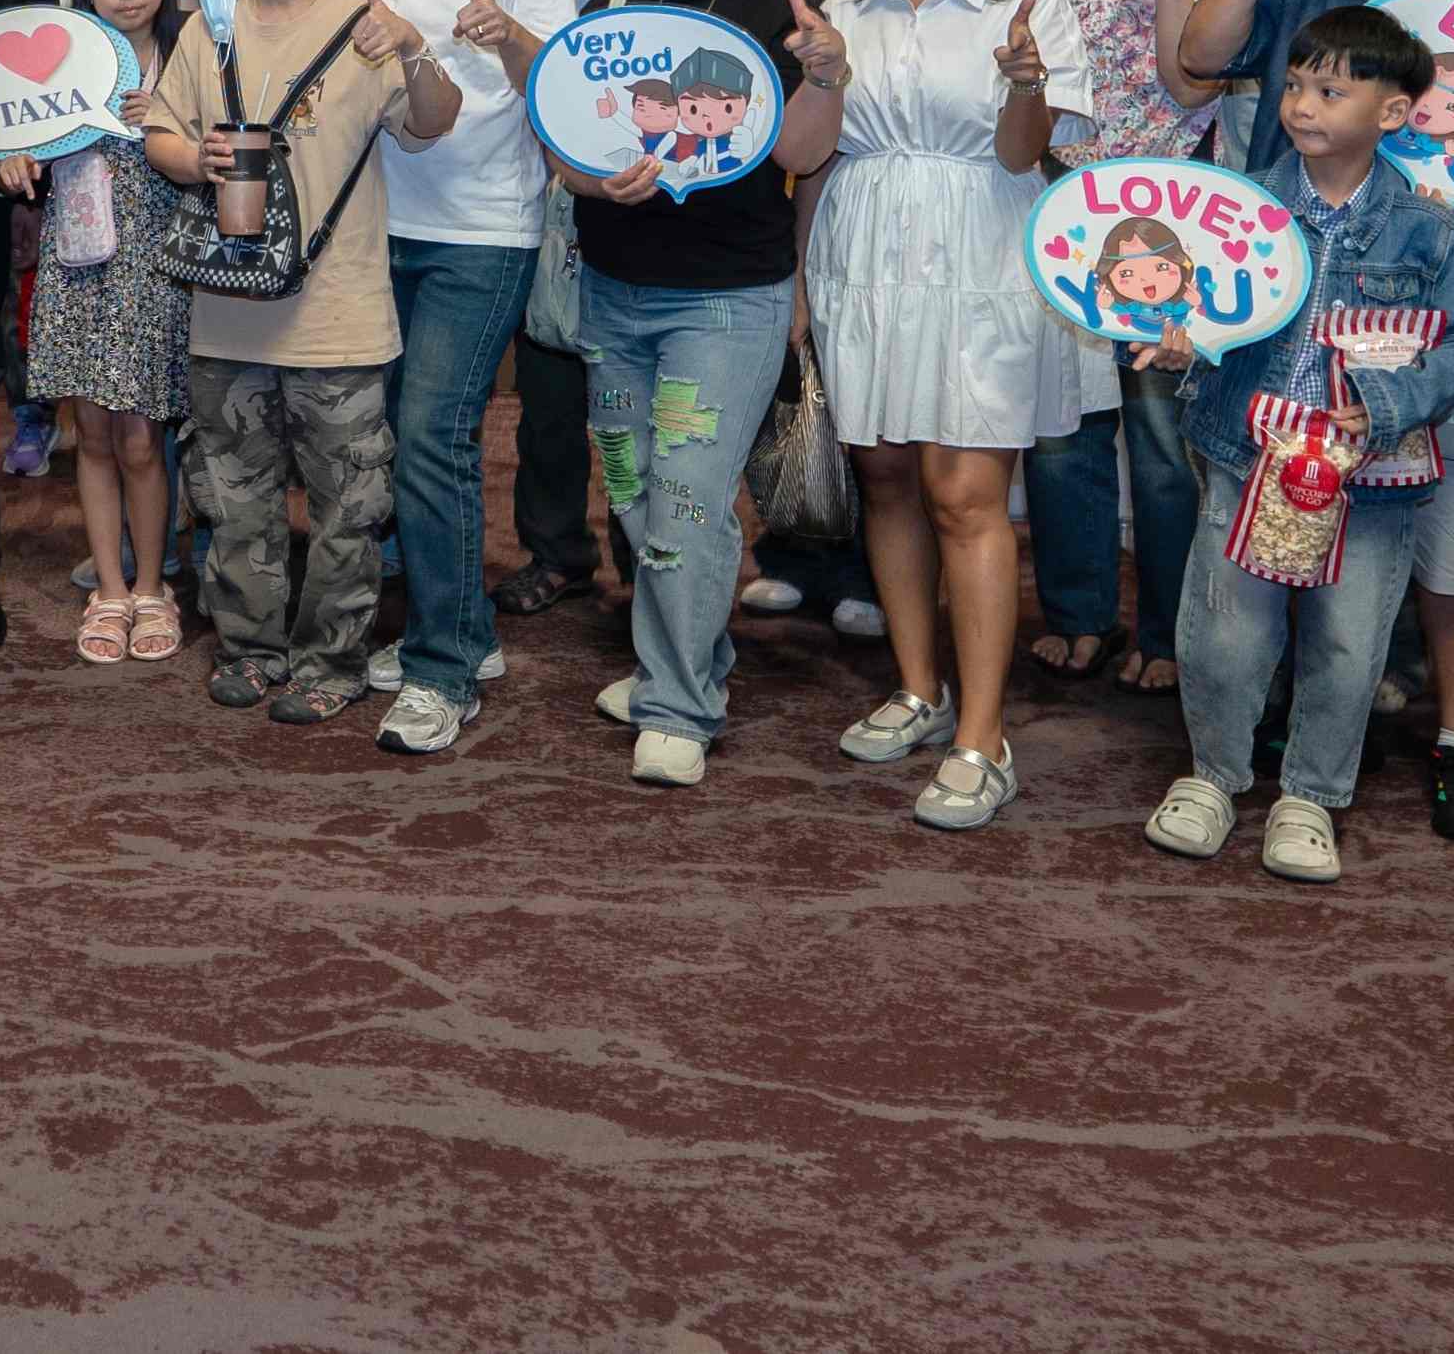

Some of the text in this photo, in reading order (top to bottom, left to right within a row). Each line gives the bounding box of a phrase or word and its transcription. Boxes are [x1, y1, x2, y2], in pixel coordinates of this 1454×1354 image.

[562, 30, 636, 58] Very
[583, 47, 672, 81] Good
[1081, 170, 1243, 240] LOVE
[1055, 265, 1254, 333] YU
